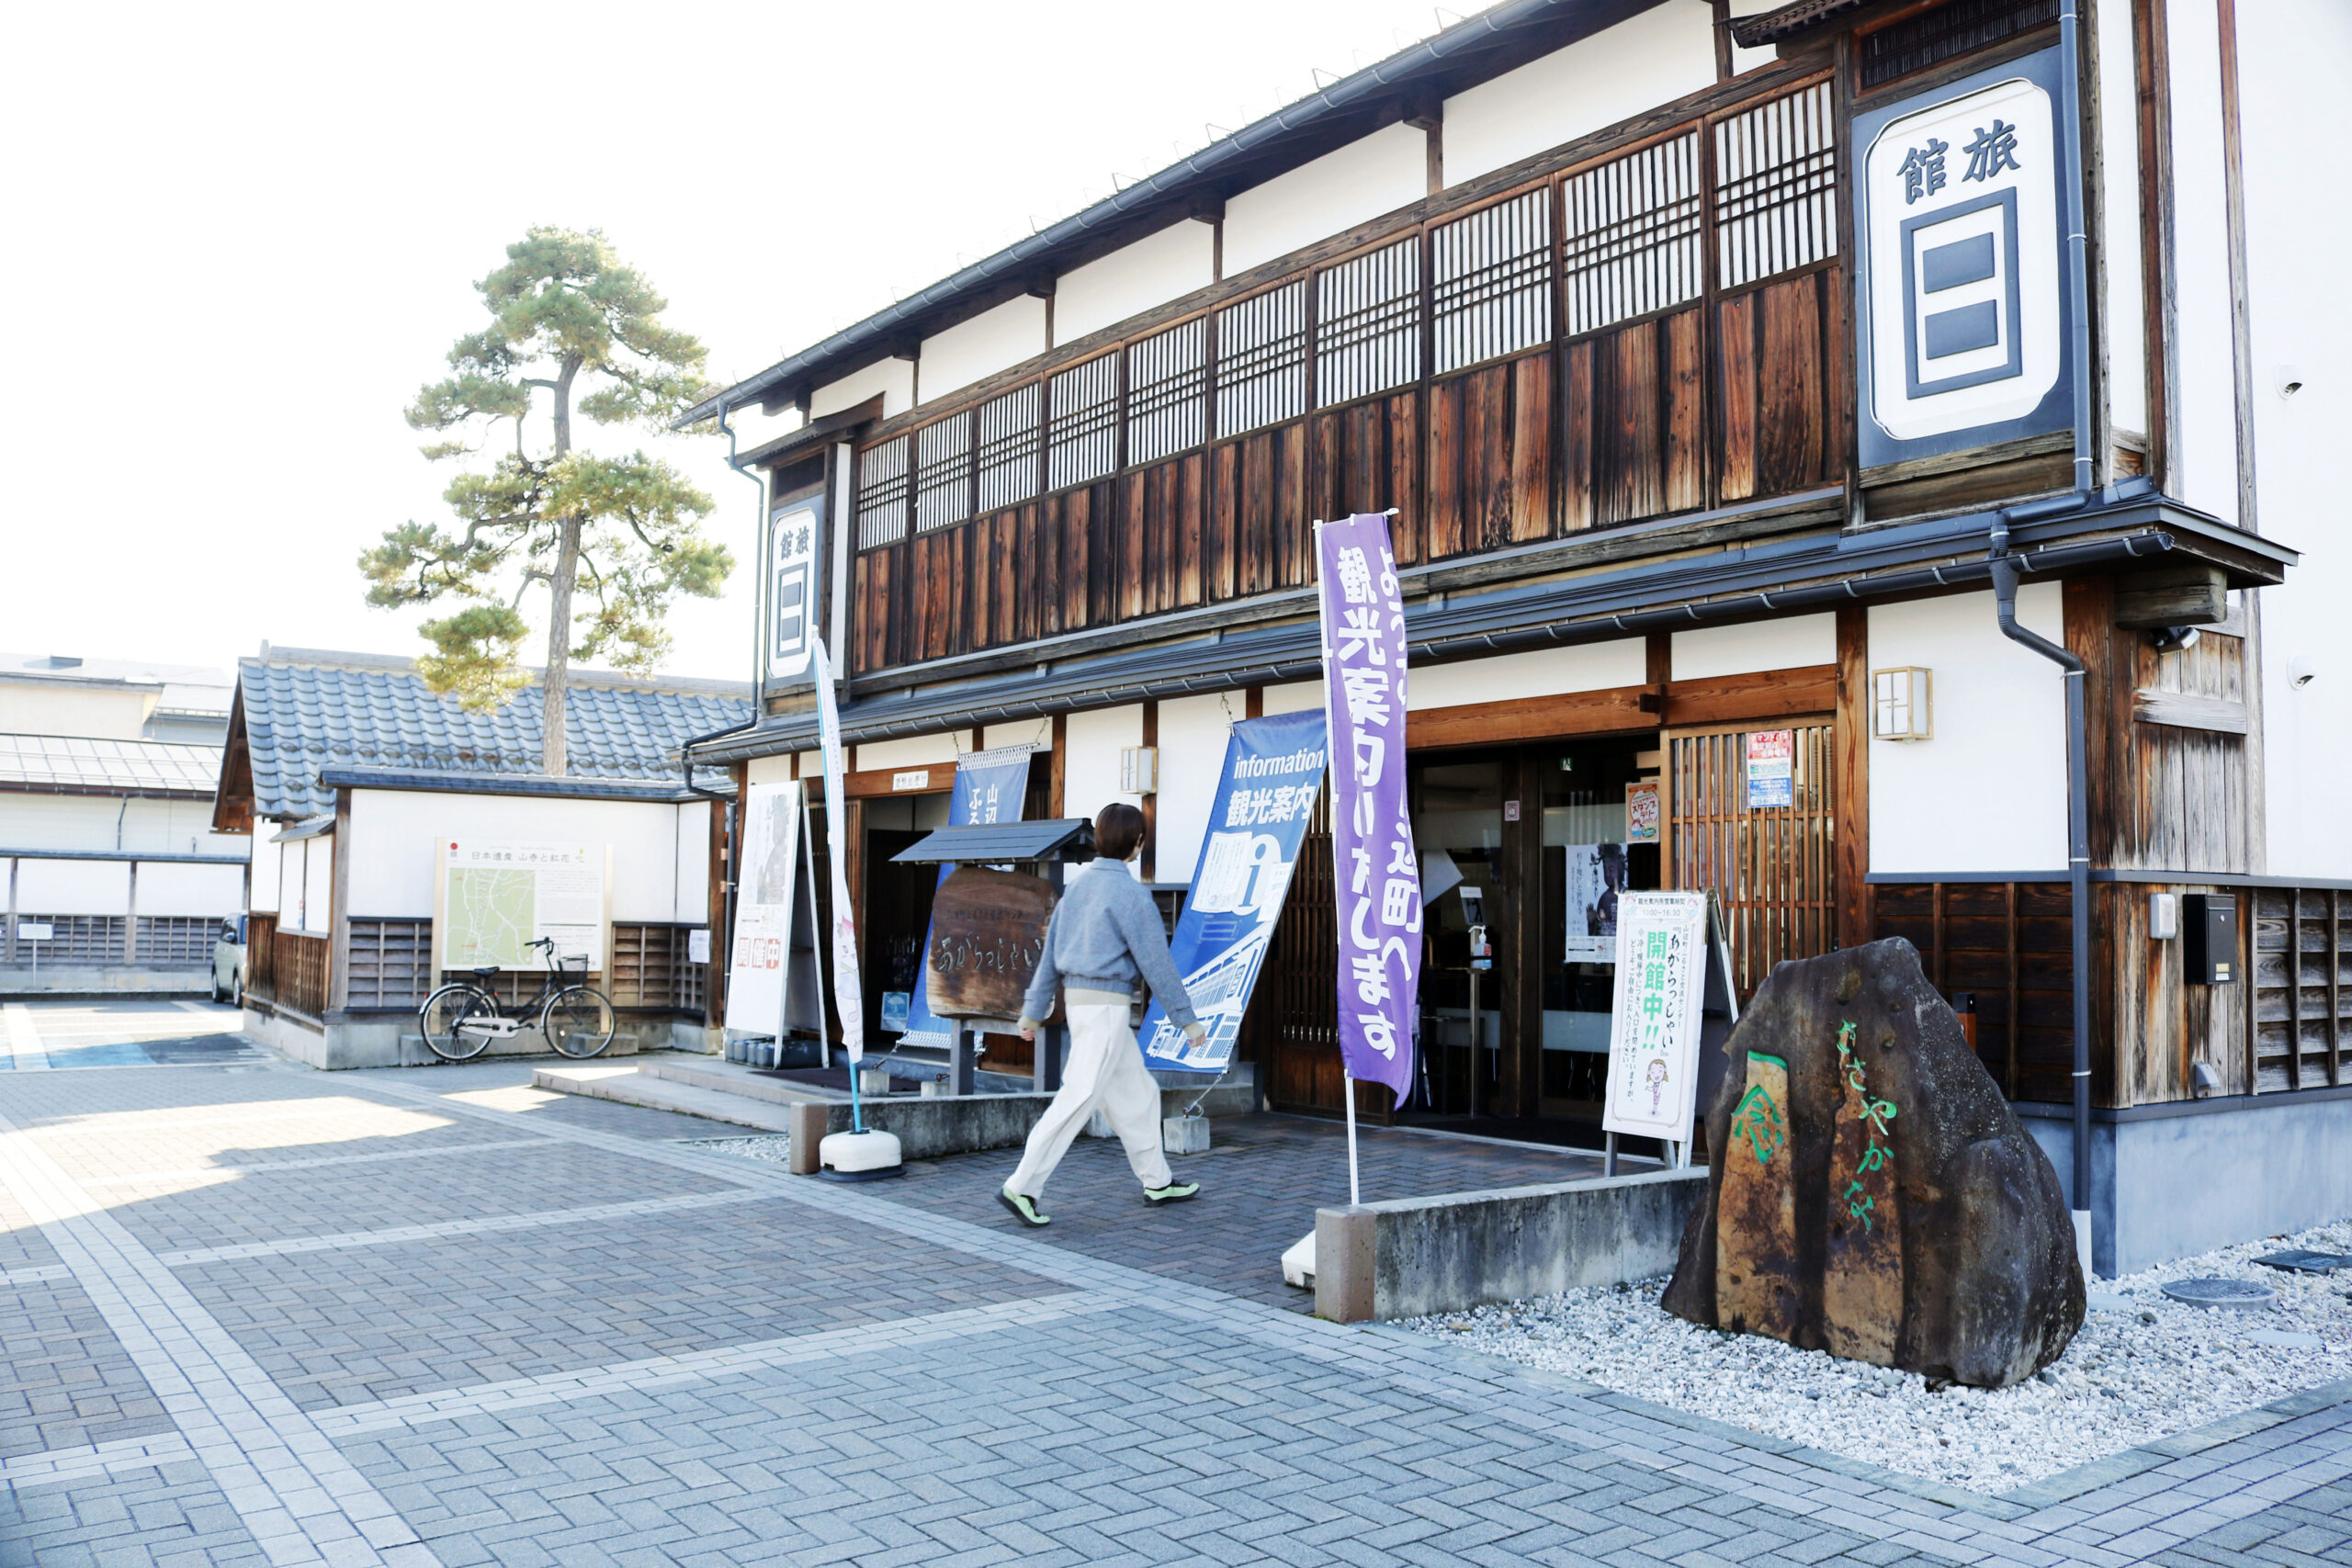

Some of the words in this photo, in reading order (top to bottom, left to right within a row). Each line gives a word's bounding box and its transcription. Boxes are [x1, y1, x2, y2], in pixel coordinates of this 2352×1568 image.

[1897, 119, 2021, 205] 旅館
[780, 525, 809, 560] 旅館
[1234, 748, 1324, 779] information
[985, 784, 997, 824] 山辺
[1226, 782, 1316, 827] 観光案内
[1338, 546, 1396, 1061] 観光案内いたします
